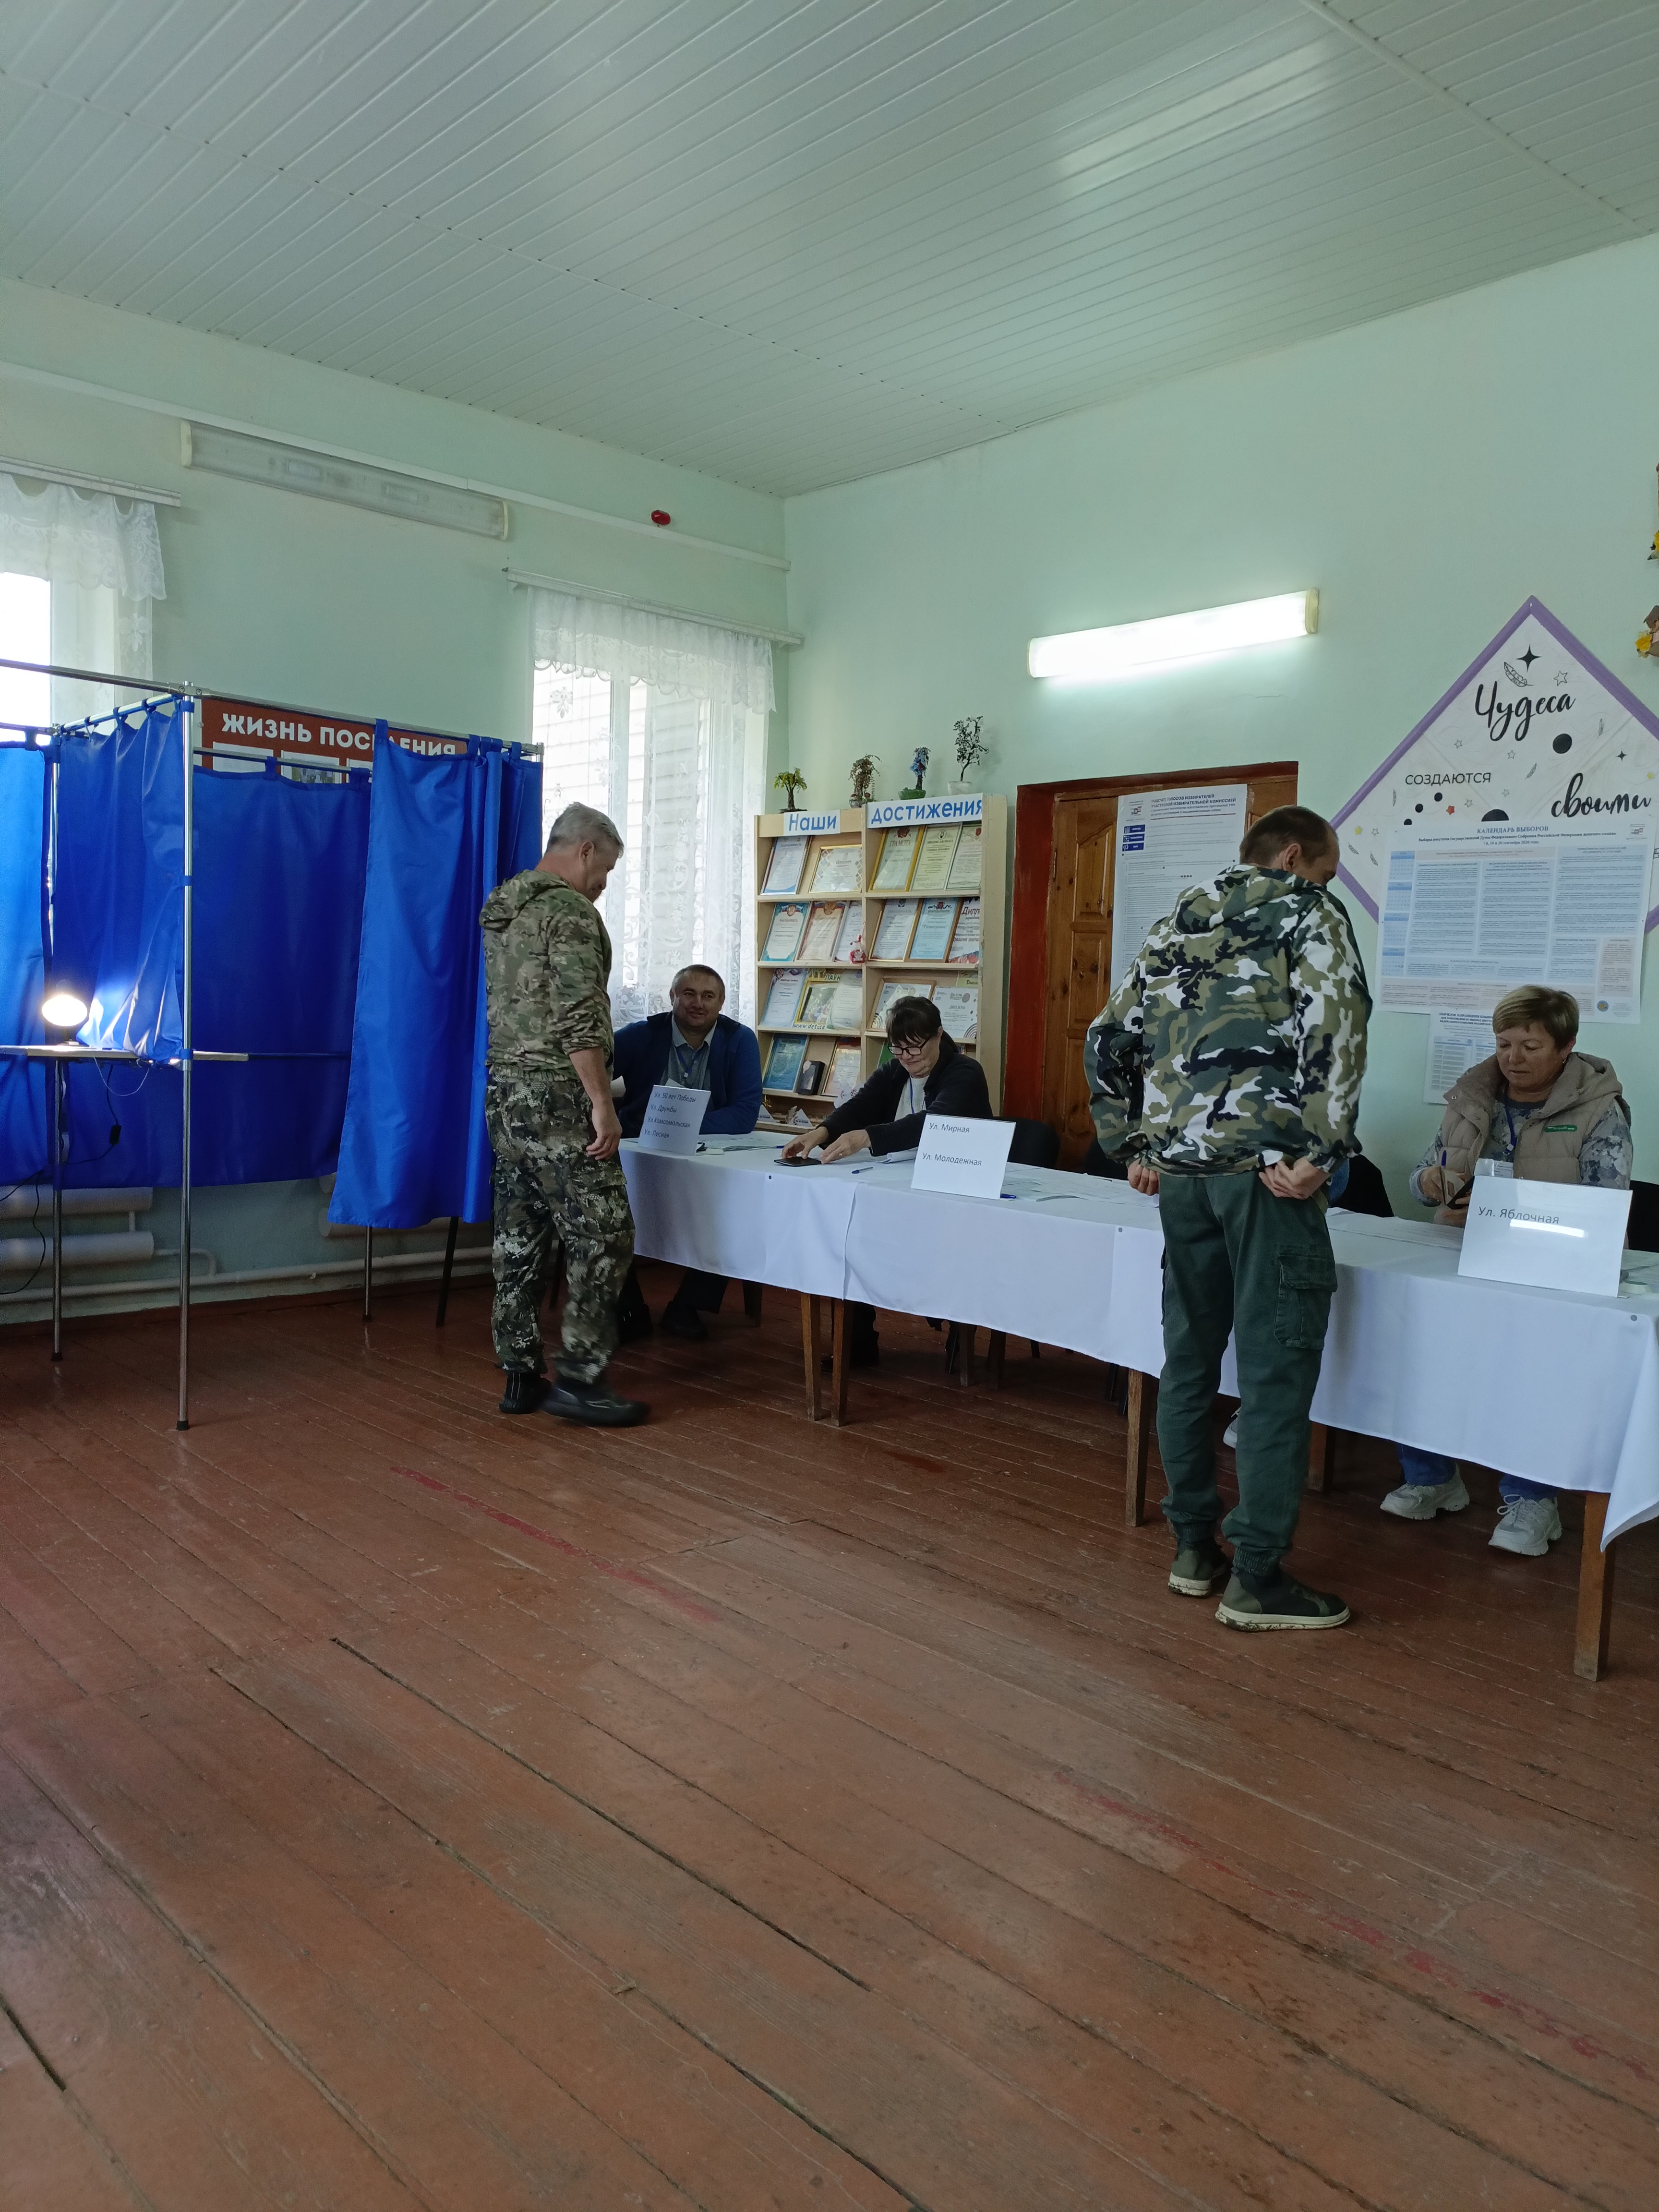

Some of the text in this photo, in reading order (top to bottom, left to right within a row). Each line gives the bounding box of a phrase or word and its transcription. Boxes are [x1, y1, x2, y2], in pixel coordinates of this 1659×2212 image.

[1475, 681, 1576, 741] Чудеса
[222, 713, 456, 756] ЖИЗНЬ ПОСЕНИЯ
[1405, 772, 1491, 786] СОЗДАЮТСЯ
[1551, 773, 1651, 818] своими
[789, 814, 837, 831] Наши
[676, 1094, 696, 1103] Победы
[652, 1130, 670, 1138] Лесная
[941, 1124, 970, 1133] Мирная
[934, 1154, 982, 1166] Молодежная
[1479, 1206, 1559, 1224] Ул. Яблочная
